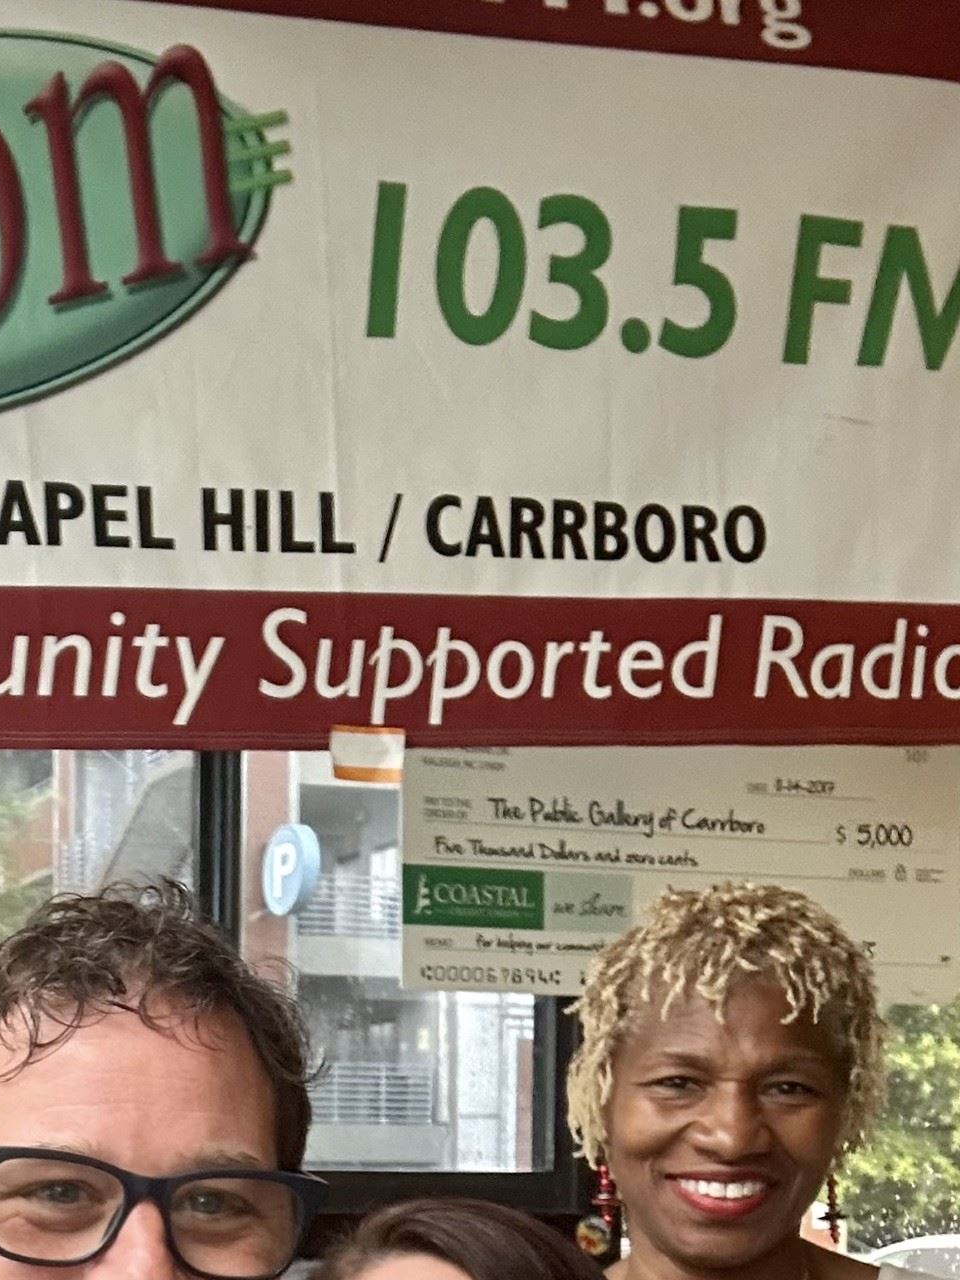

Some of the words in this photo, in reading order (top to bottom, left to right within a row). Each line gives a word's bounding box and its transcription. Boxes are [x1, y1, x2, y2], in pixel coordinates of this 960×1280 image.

[366, 180, 738, 359] 103.5
[782, 213, 960, 371] FM
[202, 487, 356, 555] HILL
[378, 493, 403, 563] /
[425, 494, 766, 564] CARRBORO
[258, 607, 723, 725] Supported
[487, 796, 526, 820] The
[529, 796, 583, 823] Public
[589, 799, 655, 838] Gallery
[658, 807, 677, 831] of
[681, 808, 765, 834] Carrboro
[836, 825, 847, 845] $
[857, 823, 913, 848] 5,000
[271, 842, 297, 898] P
[434, 836, 465, 855] Five
[594, 848, 621, 863] and
[434, 882, 535, 907] COASTAL
